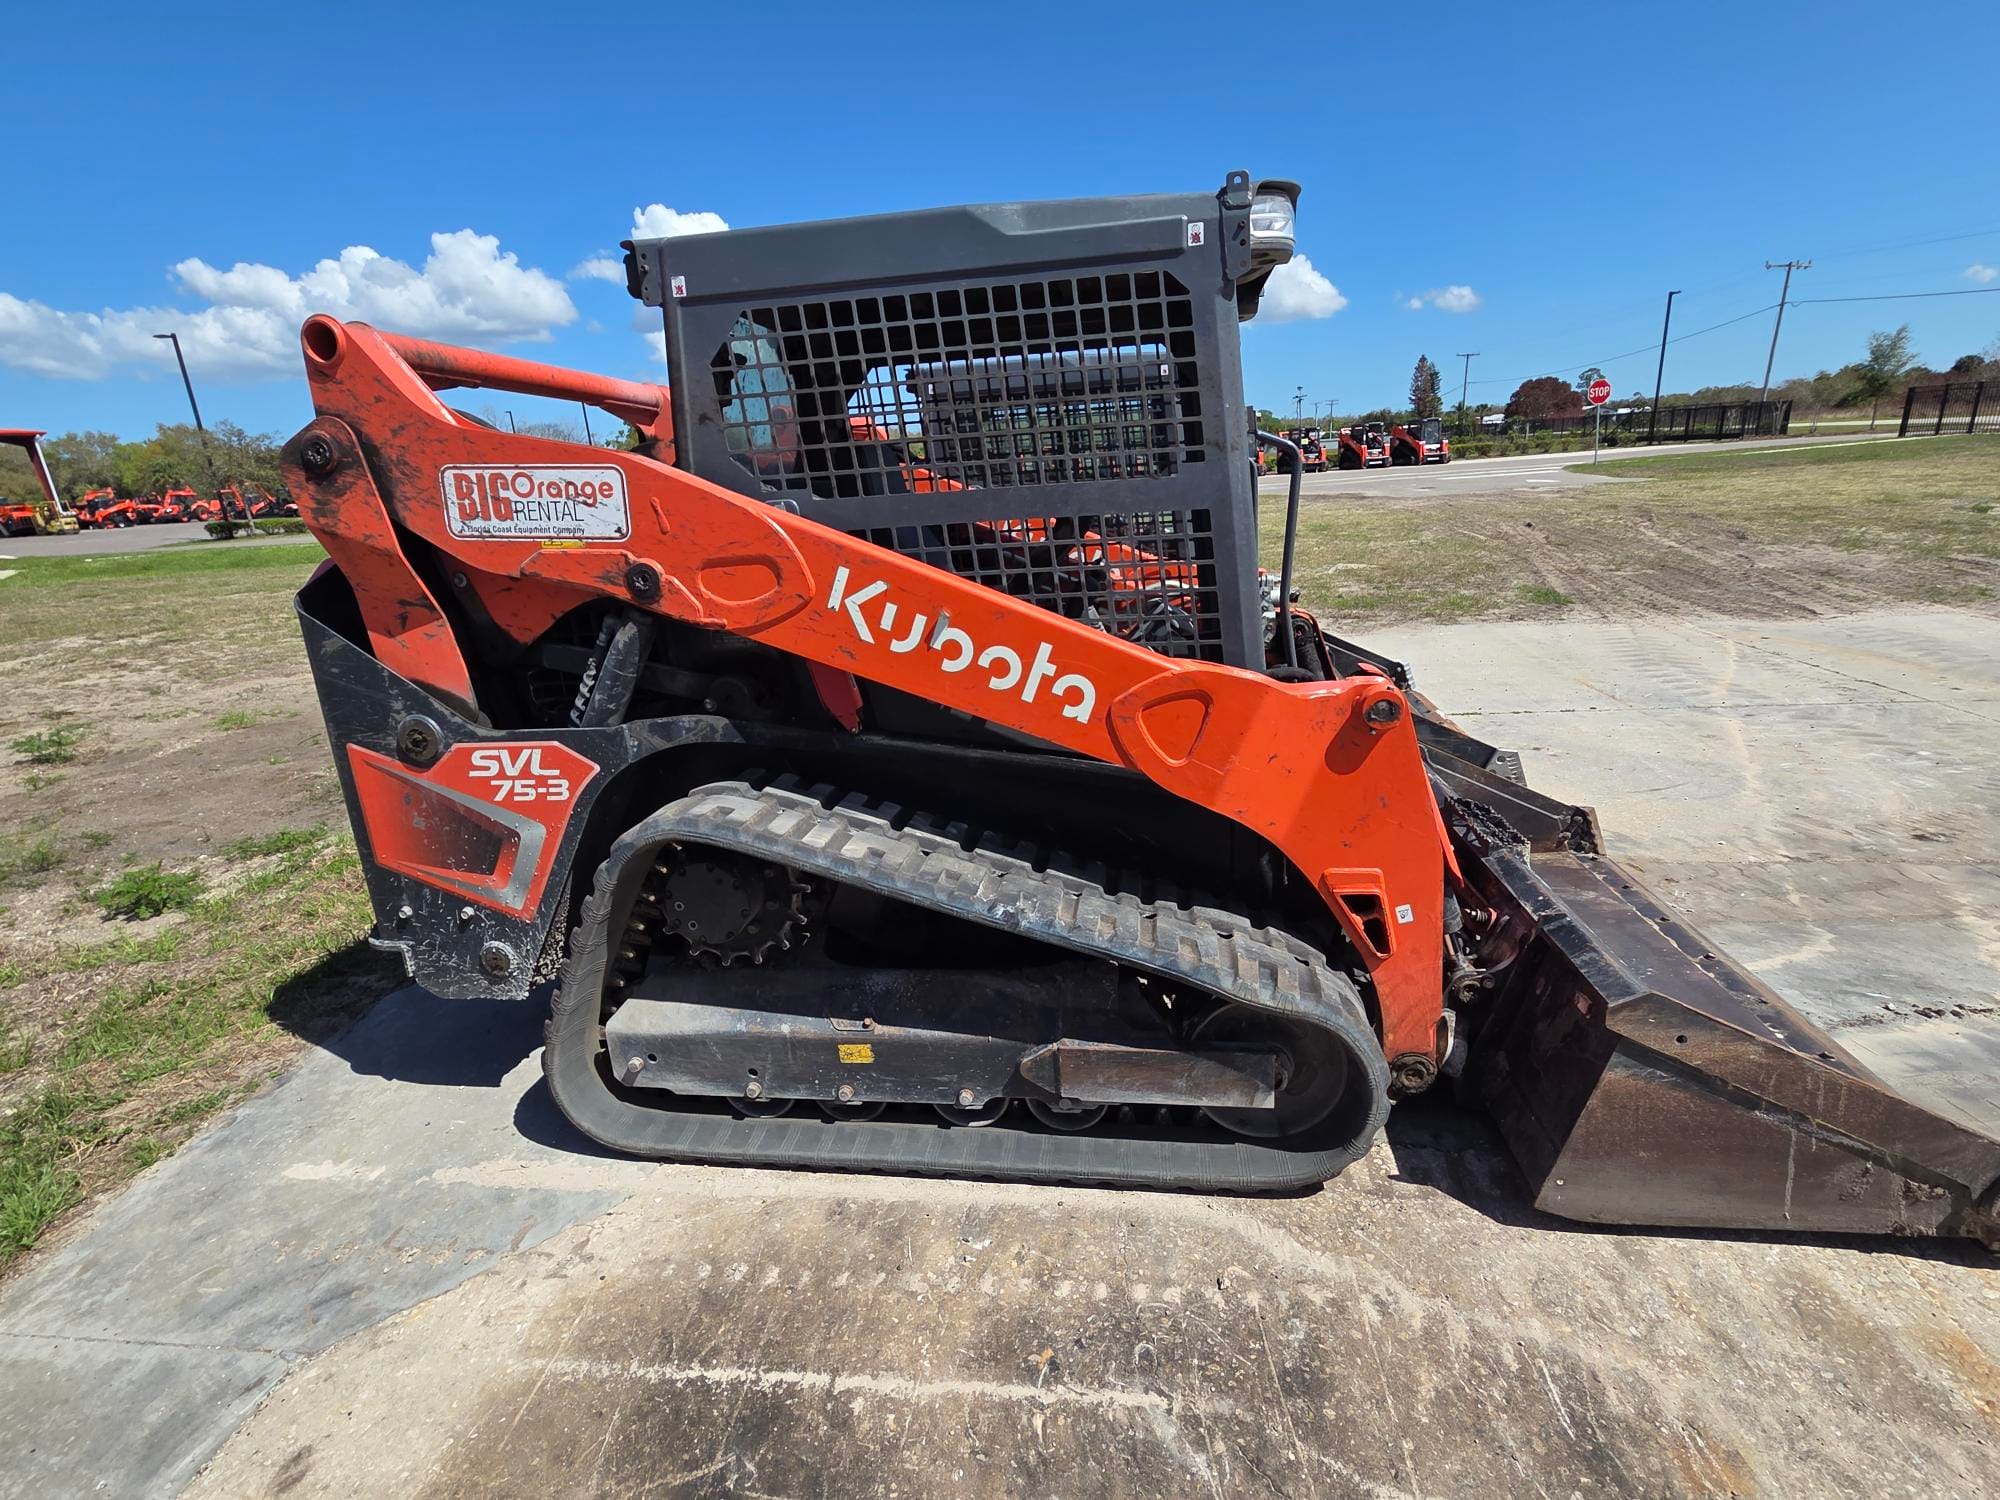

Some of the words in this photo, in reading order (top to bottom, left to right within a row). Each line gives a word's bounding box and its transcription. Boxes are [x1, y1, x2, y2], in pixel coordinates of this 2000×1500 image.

[1589, 386, 1610, 398] STOP
[453, 472, 515, 522] BIG
[510, 471, 614, 508] Orange
[514, 500, 585, 522] RENTAL
[492, 525, 512, 533] Coast
[513, 525, 550, 535] Equipment
[552, 525, 585, 535] Company
[827, 565, 1096, 724] Kubota
[468, 748, 561, 777] SVL
[490, 779, 570, 802] 75-3
